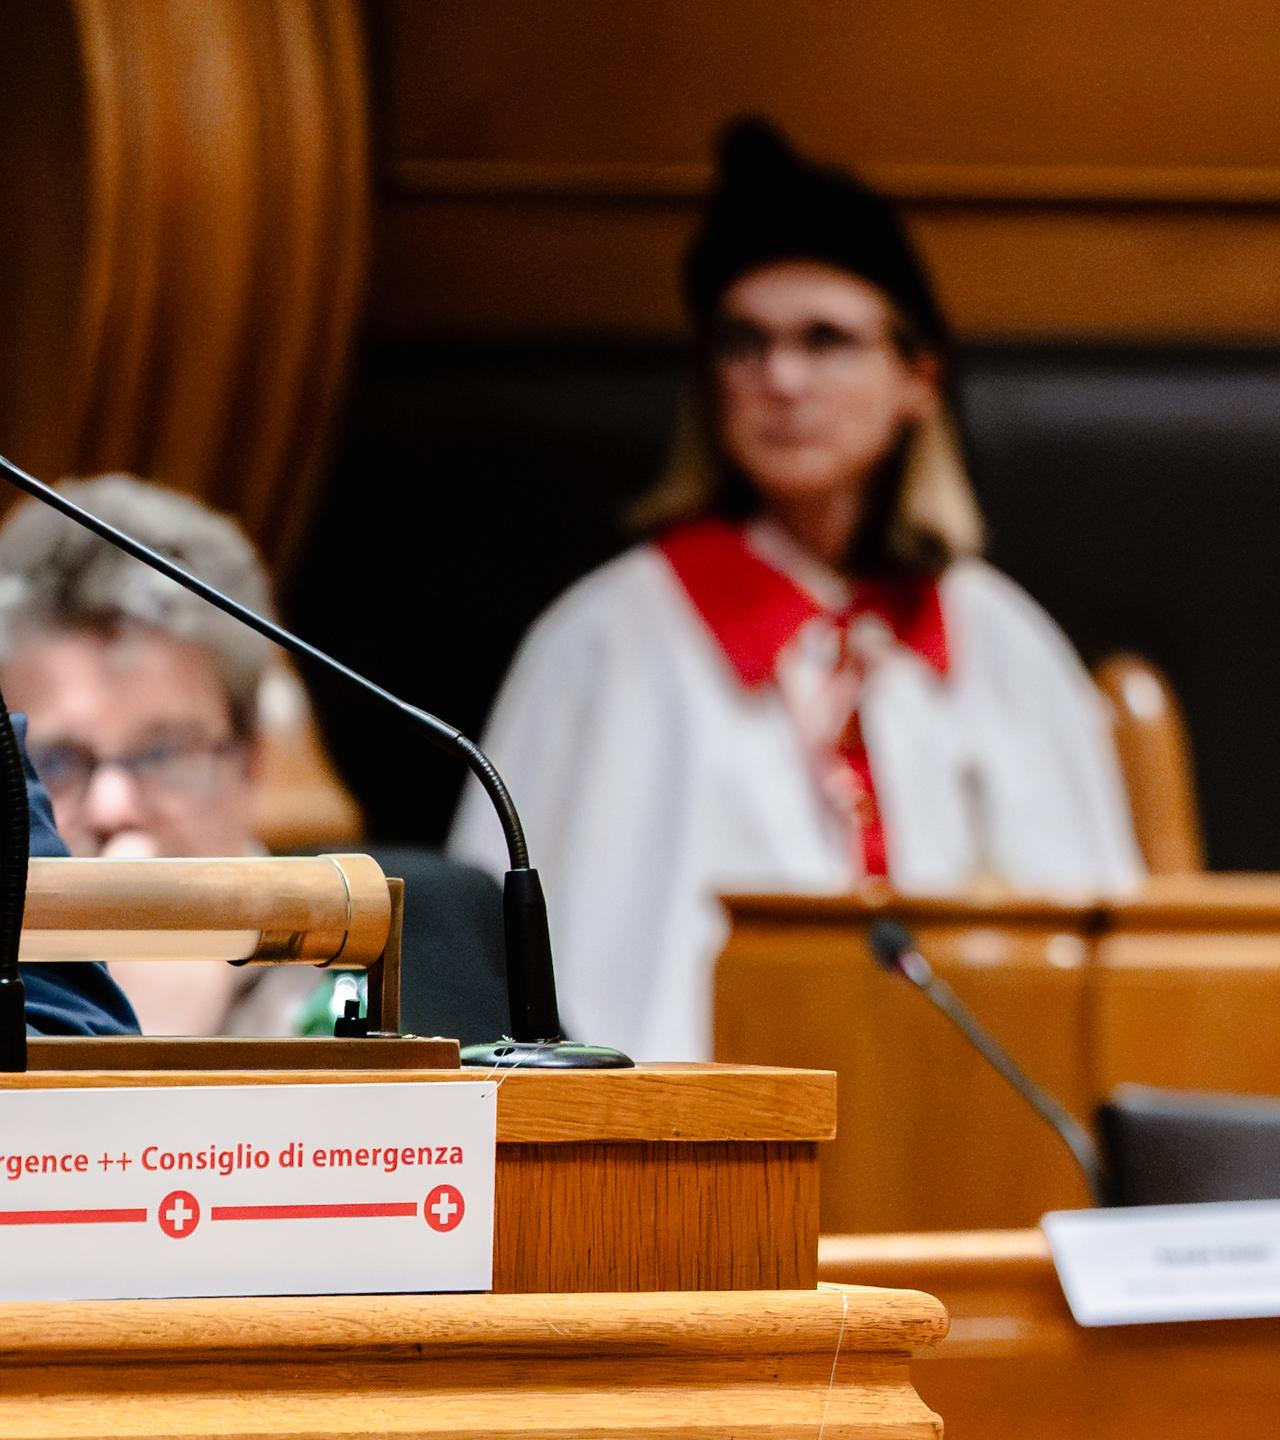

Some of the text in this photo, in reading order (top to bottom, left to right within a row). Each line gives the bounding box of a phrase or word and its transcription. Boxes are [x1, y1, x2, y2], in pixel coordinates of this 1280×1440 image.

[140, 1142, 271, 1177] Consiglio
[277, 1141, 305, 1169] di
[311, 1145, 465, 1174] emergenza
